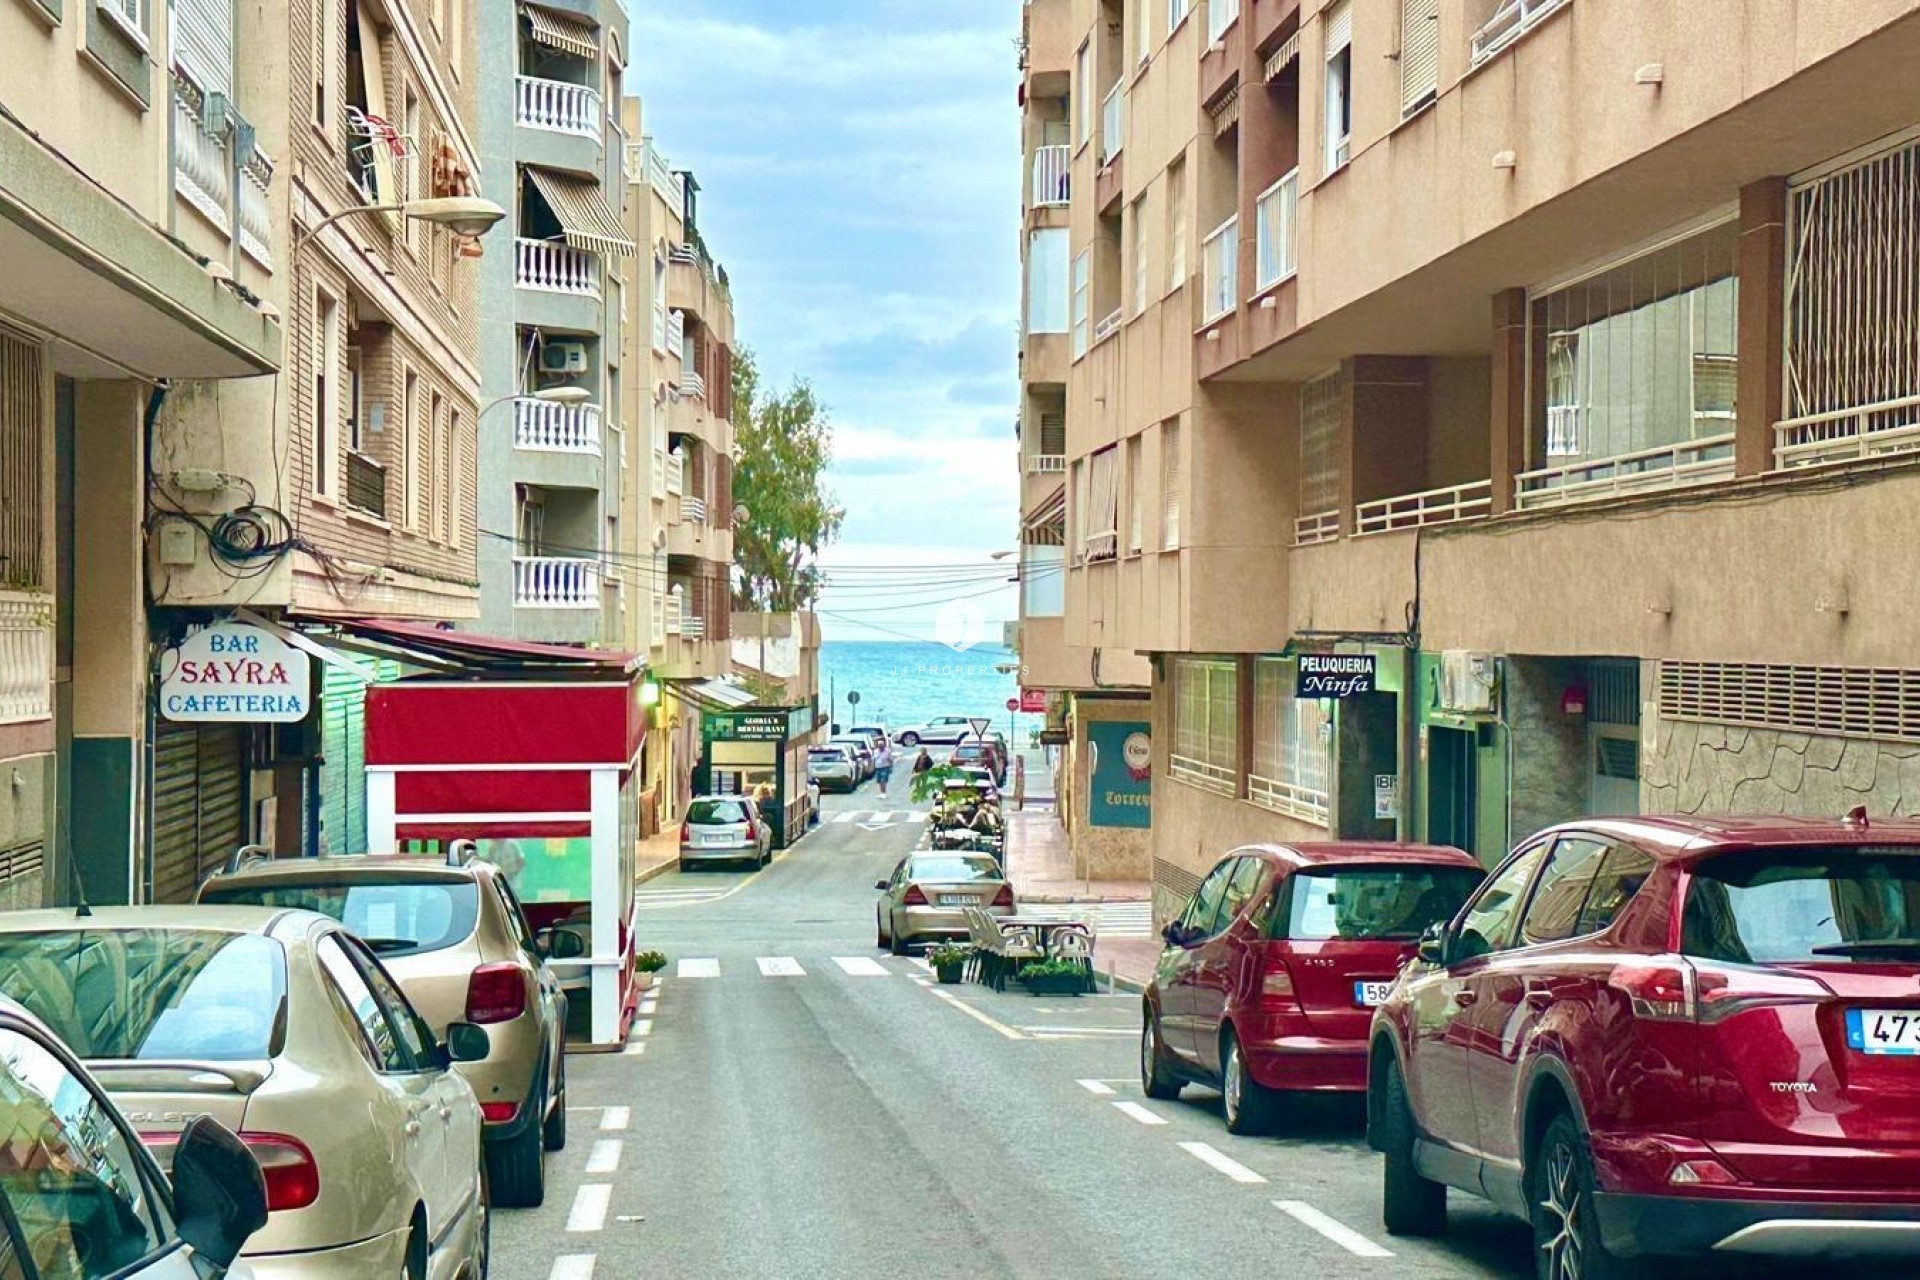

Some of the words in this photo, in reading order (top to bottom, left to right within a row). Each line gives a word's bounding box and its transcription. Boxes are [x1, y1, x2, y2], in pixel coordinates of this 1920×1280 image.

[211, 634, 258, 653] BAR
[180, 657, 290, 685] SAYRA
[1300, 656, 1373, 674] PELUQUERIA
[1303, 675, 1369, 697] Ninfa
[168, 694, 302, 714] CAFETERIA
[1769, 1081, 1818, 1093] TOYOTA
